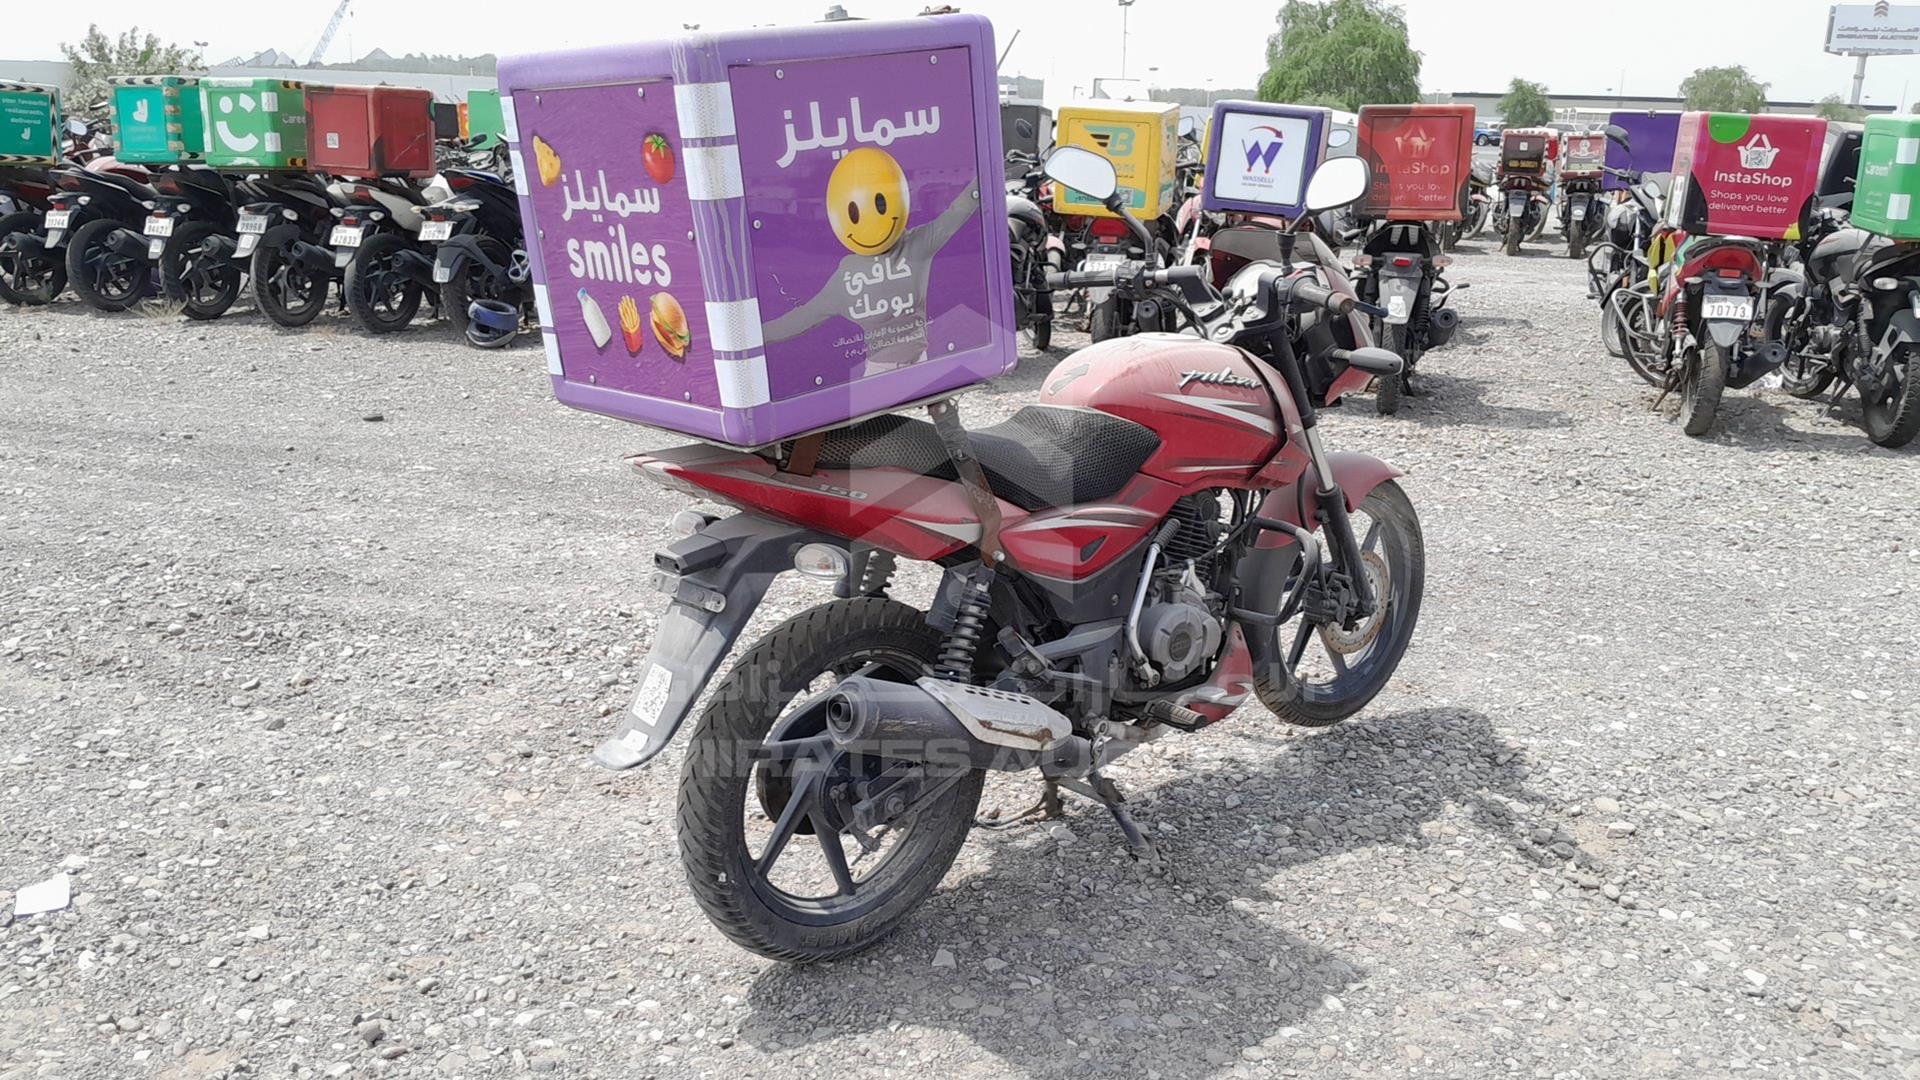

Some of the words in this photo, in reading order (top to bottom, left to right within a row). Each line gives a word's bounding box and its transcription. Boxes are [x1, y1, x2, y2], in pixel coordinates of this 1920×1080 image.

[775, 96, 941, 169] سمايلز
[1714, 169, 1793, 188] InstaShop
[561, 169, 661, 223] سمايلز
[1710, 189, 1742, 201] Shops
[1745, 194, 1765, 203] you
[1767, 193, 1789, 203] love
[1708, 202, 1754, 213] delivered
[1756, 204, 1788, 215] better
[566, 223, 672, 288] smiles
[842, 255, 912, 296] كافئ
[848, 292, 914, 320] يومك
[1709, 304, 1746, 318] 70773
[819, 484, 869, 499] 150
